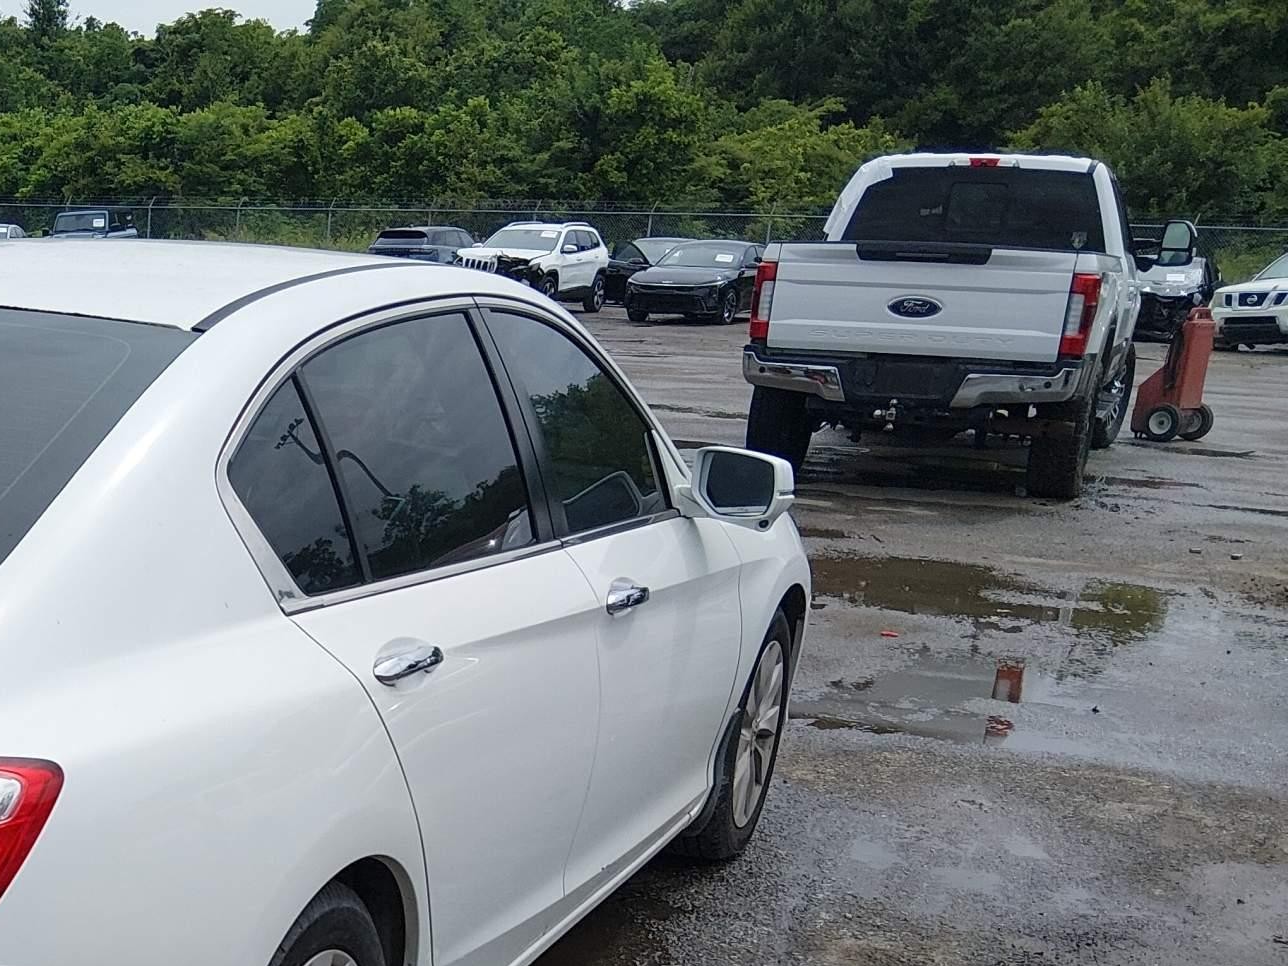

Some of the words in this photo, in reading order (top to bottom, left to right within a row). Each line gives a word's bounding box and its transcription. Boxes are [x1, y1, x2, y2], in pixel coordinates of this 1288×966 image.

[899, 299, 930, 314] Ford
[807, 328, 919, 343] SUPER
[926, 333, 1016, 347] DUTY
